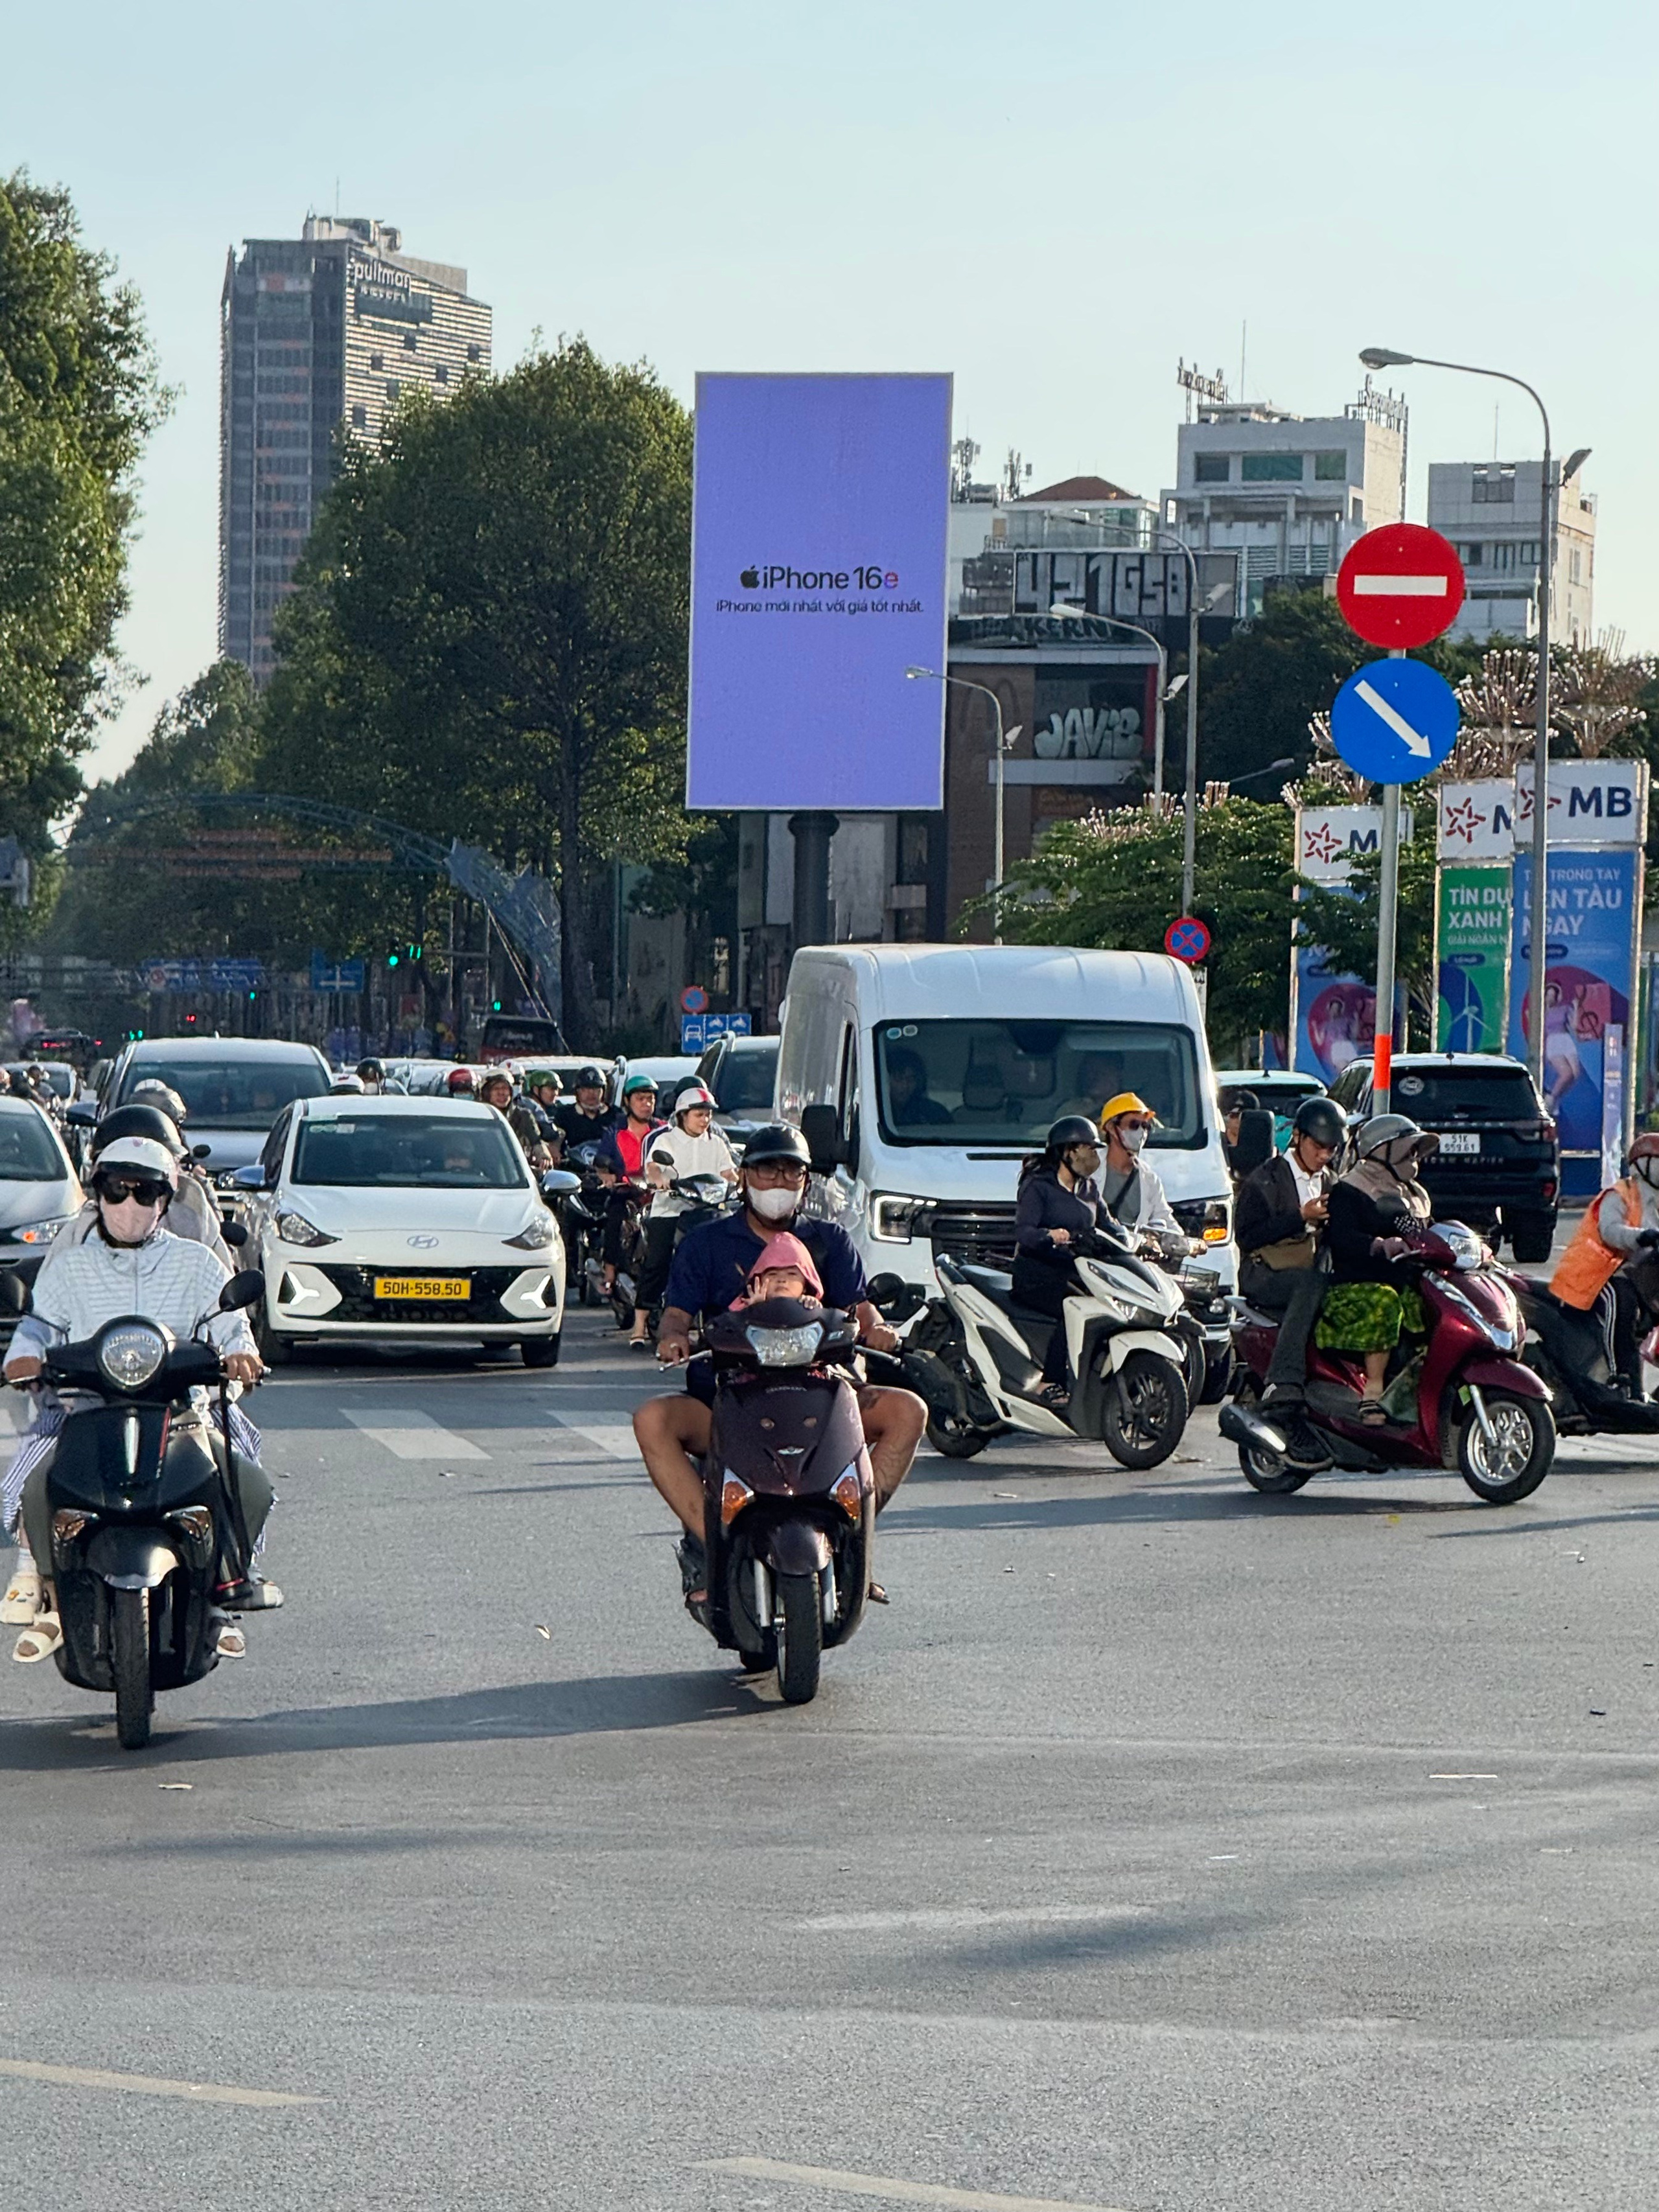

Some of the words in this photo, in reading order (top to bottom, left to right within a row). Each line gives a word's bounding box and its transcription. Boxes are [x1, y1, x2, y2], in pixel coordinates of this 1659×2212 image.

[763, 565, 849, 590] iPhone
[852, 566, 899, 590] 16e
[716, 599, 762, 612] iPhone
[826, 599, 845, 612] với
[848, 599, 868, 615] giá
[871, 599, 888, 612] tốt
[1568, 786, 1632, 818] MB
[1492, 805, 1511, 834] M
[1349, 829, 1378, 852] M
[1550, 868, 1593, 881] TRONG
[1596, 868, 1621, 881] TAY
[1523, 887, 1568, 910] LN
[1573, 883, 1622, 910] TÀU
[1448, 911, 1502, 929] XANH
[383, 1281, 462, 1295] 50H-558.50
